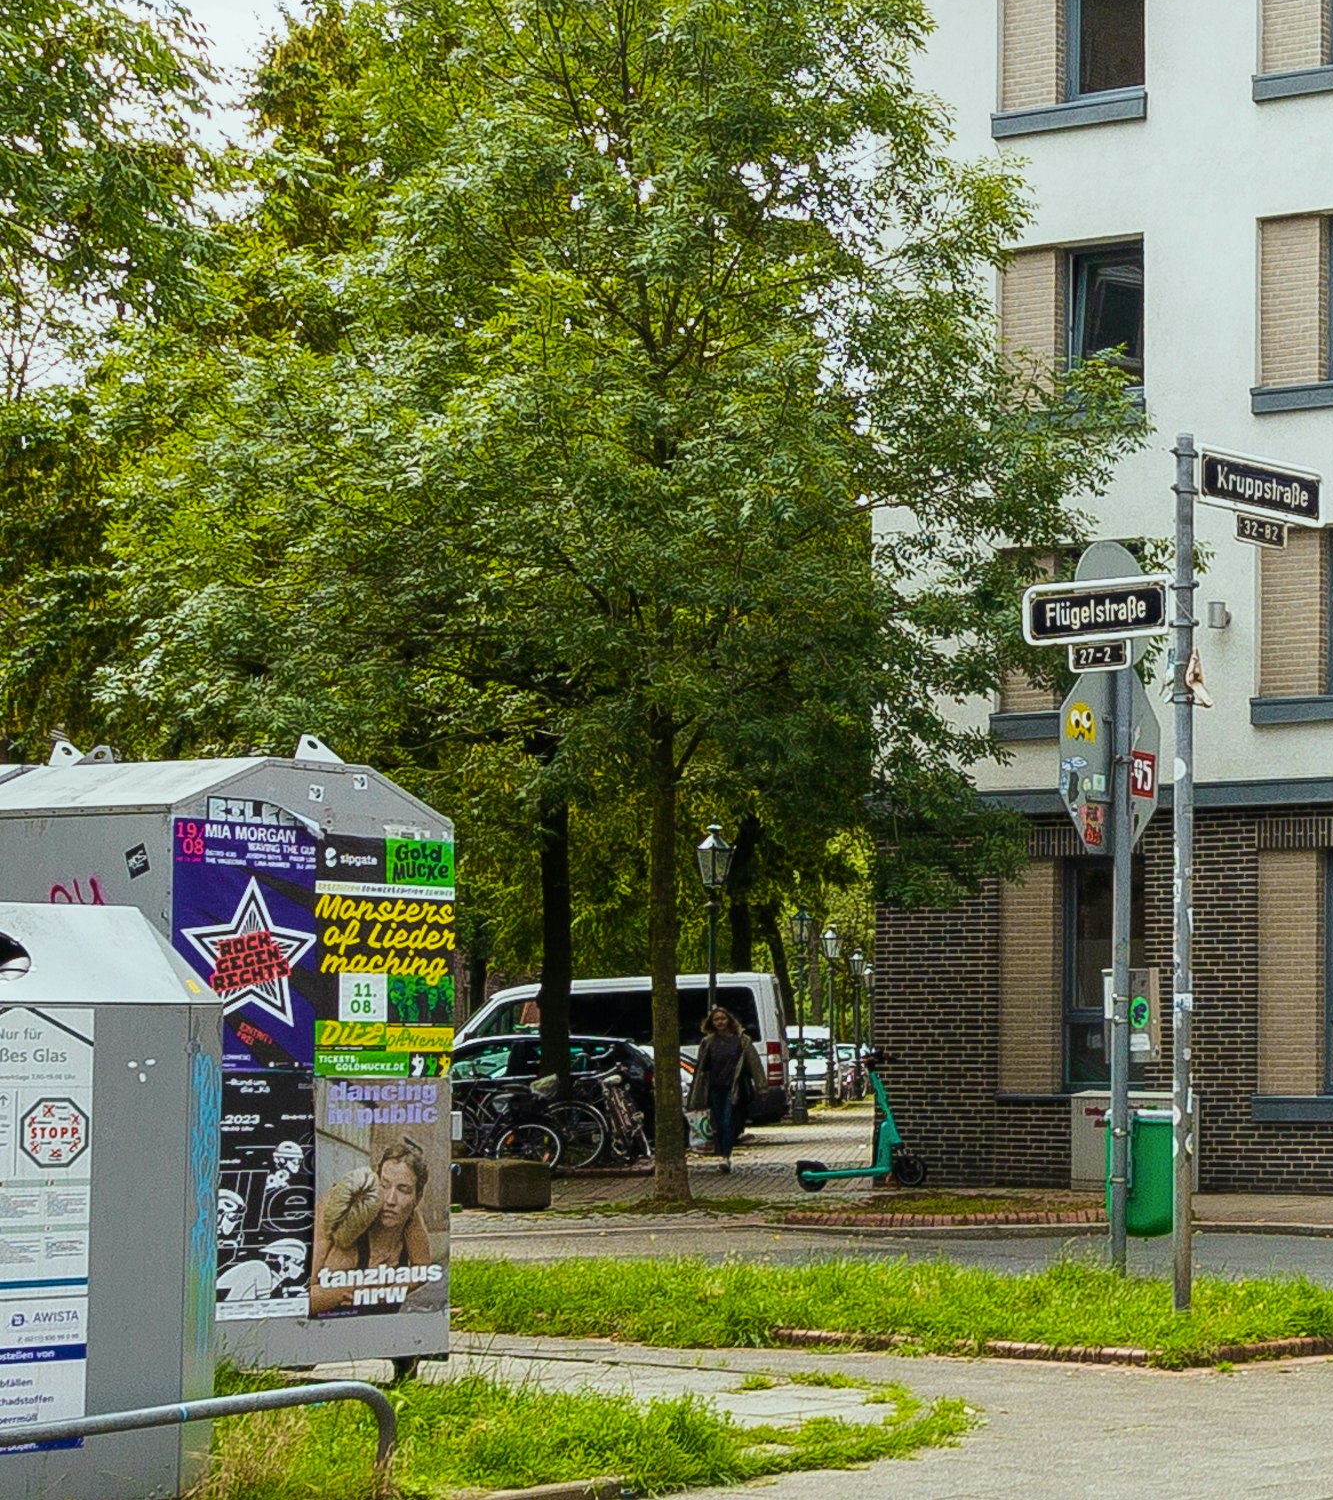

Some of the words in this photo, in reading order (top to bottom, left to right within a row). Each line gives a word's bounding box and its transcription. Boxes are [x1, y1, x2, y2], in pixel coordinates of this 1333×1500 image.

[1216, 464, 1310, 508] Kruppstraße
[1243, 519, 1279, 541] 32-82
[1045, 594, 1147, 630] Flügelstraße
[1079, 647, 1112, 663] 27-2
[1131, 759, 1152, 791] 95
[205, 823, 231, 840] MIA
[235, 826, 297, 844] MORGAN
[182, 838, 204, 855] 08
[283, 845, 299, 855] THE
[395, 843, 442, 863] Gold
[340, 852, 378, 867] sipgate
[315, 894, 455, 925] Monsters
[220, 934, 271, 957] ROCK
[323, 919, 360, 955] of
[367, 922, 456, 950] Lieder
[217, 946, 279, 974] GEGEN
[320, 949, 448, 986] maching
[212, 959, 290, 991] RECHTS
[354, 983, 377, 998] 11.
[350, 999, 376, 1014] 08.
[24, 1027, 43, 1040] für
[33, 1048, 67, 1063] Glas
[329, 1081, 438, 1106] dancing
[327, 1103, 353, 1125] in
[356, 1102, 438, 1129] public
[31, 1127, 79, 1140] STOPP
[318, 1263, 443, 1289] tanzhaus
[353, 1286, 409, 1306] nrw
[33, 1310, 79, 1324] AWISTA
[36, 1349, 55, 1359] von
